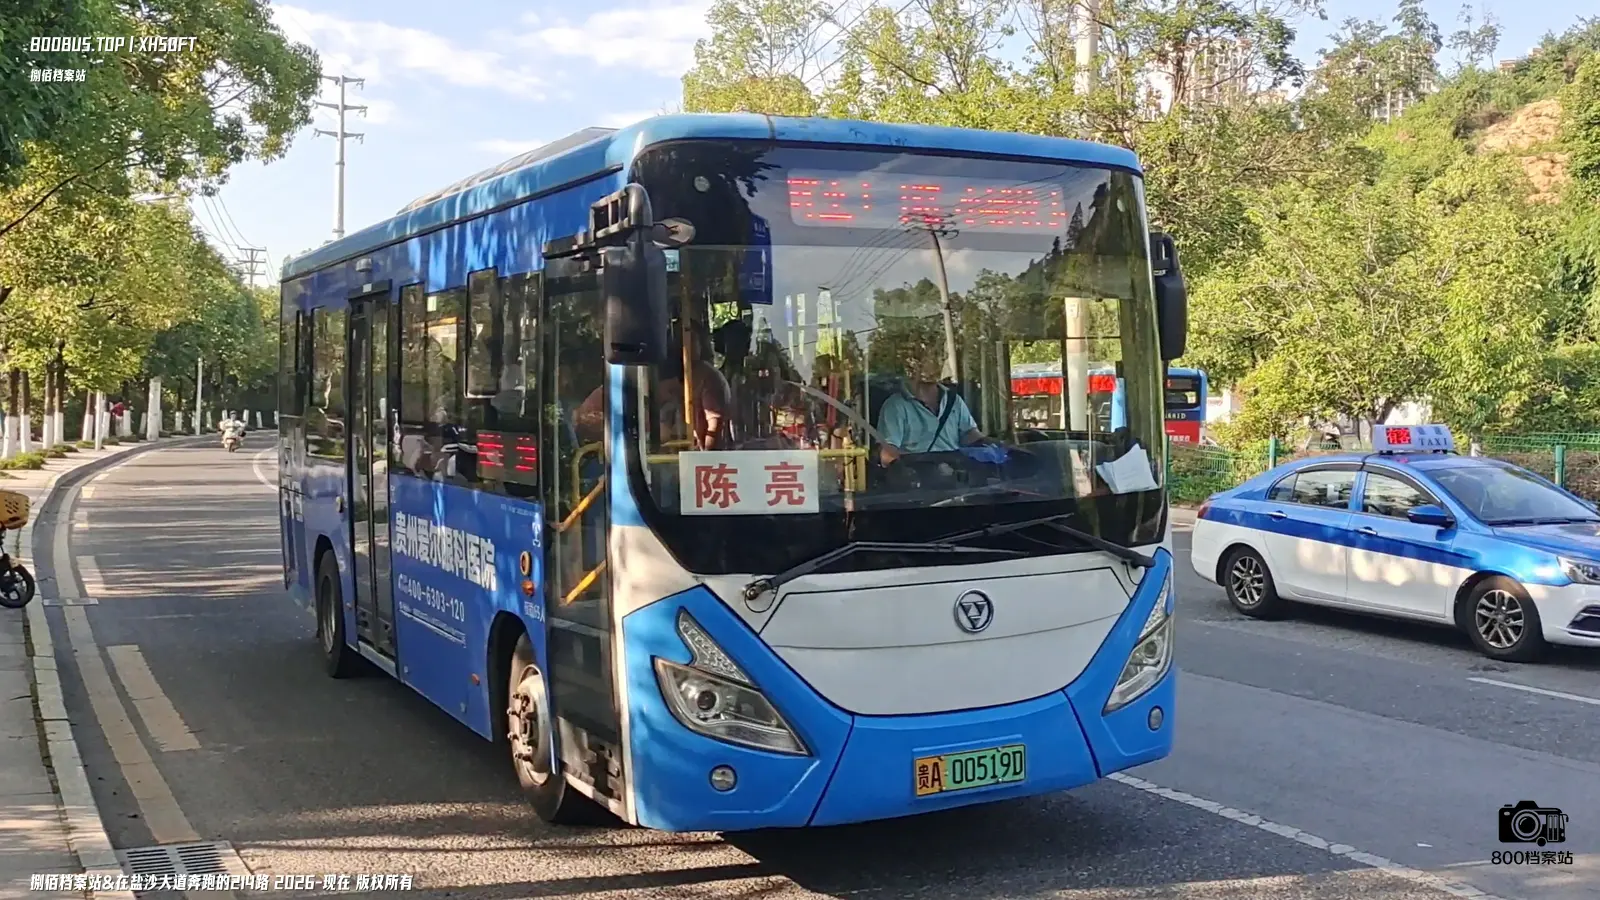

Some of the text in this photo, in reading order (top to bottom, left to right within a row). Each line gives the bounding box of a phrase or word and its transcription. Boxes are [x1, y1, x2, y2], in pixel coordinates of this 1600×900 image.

[1419, 437, 1447, 446] TAXI
[395, 511, 497, 591] 贵州爱尔眼科医院
[408, 578, 465, 622] 400-6303-120
